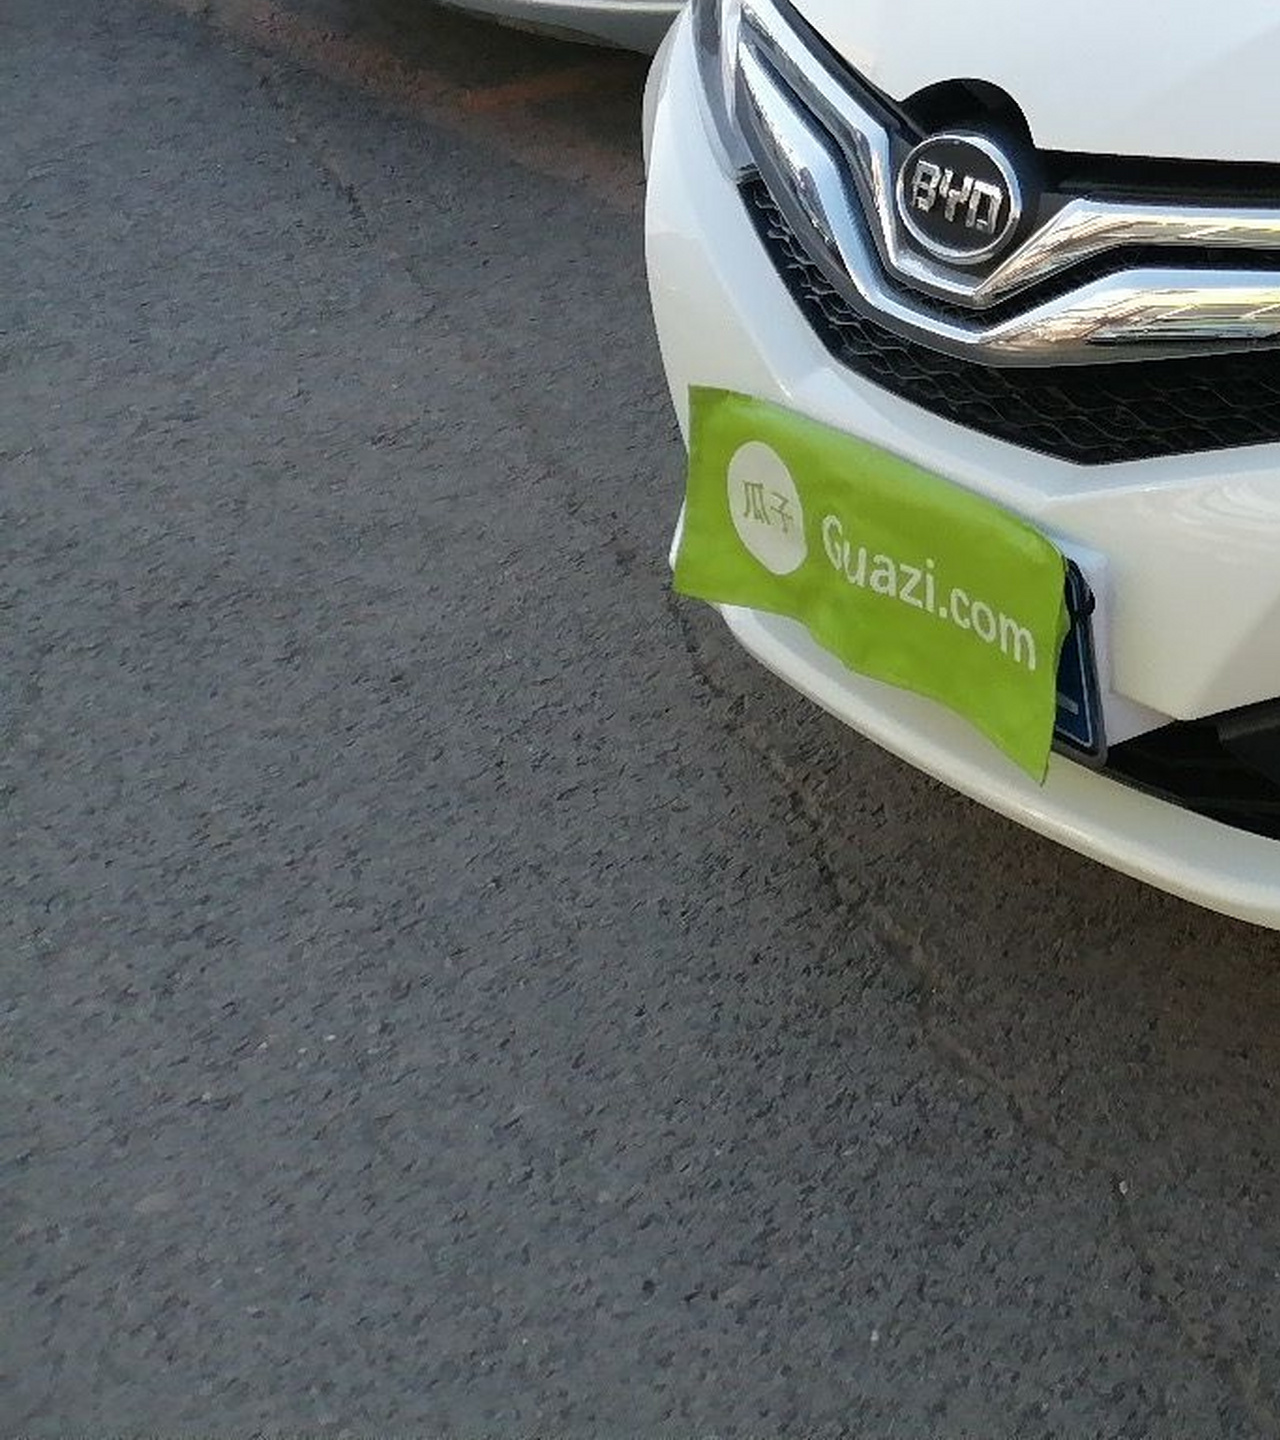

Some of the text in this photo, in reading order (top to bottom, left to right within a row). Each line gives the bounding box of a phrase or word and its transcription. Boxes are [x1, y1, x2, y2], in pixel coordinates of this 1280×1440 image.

[911, 159, 1003, 234] BYD
[742, 479, 794, 534] 瓜子
[821, 514, 1037, 671] Guazi.com
